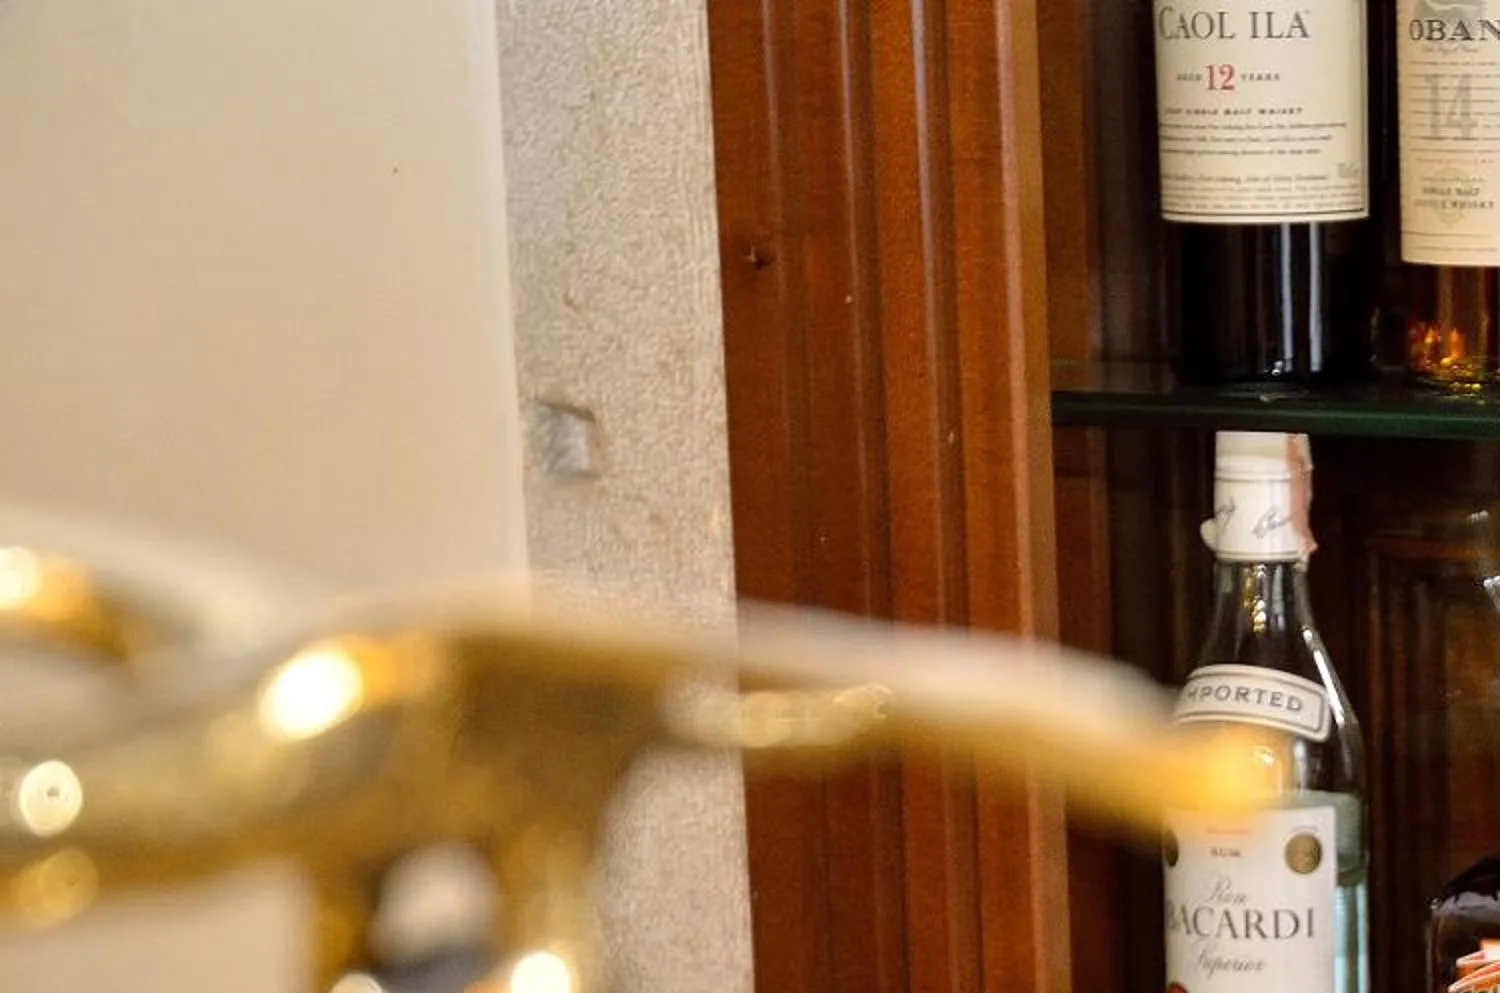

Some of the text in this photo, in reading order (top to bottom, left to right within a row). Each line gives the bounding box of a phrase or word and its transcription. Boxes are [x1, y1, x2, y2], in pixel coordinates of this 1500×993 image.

[1159, 5, 1310, 40] CAOL ILA
[1205, 64, 1235, 90] 12
[1187, 684, 1302, 712] MPORTED
